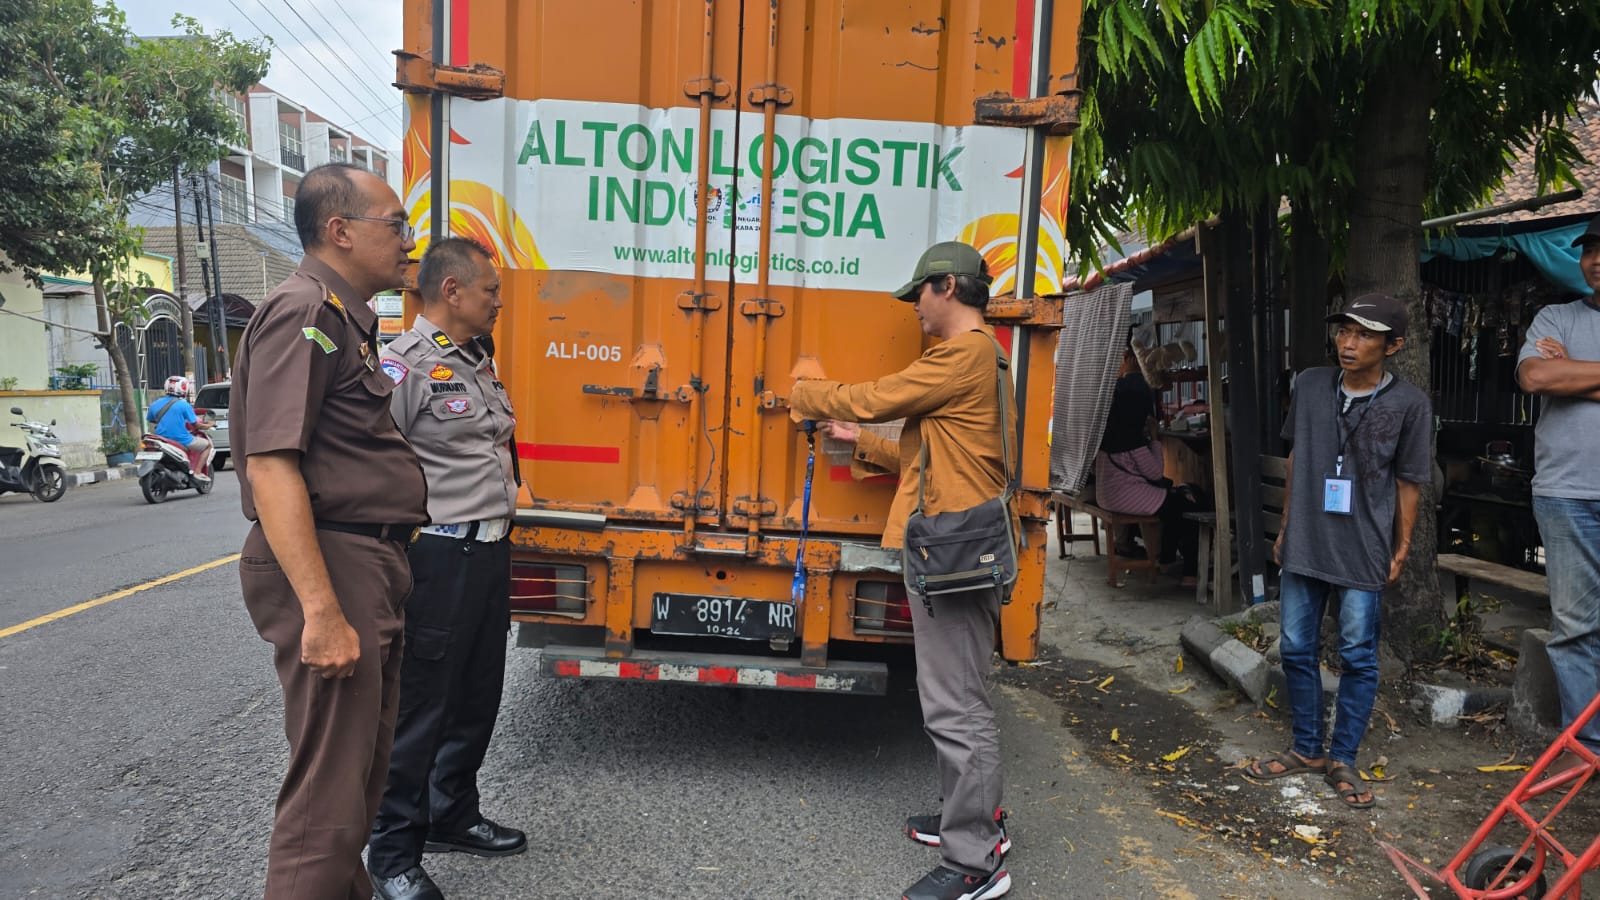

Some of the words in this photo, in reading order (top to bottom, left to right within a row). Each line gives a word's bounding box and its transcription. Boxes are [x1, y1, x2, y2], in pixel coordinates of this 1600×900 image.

[517, 119, 695, 173] ALTON
[711, 129, 965, 192] LOGISTIK
[588, 175, 886, 239] INDESIA
[613, 245, 860, 276] www.altnlogitics.co.id
[545, 341, 621, 361] ALI-005
[656, 597, 670, 620] W
[697, 599, 747, 623] 8914
[768, 602, 793, 628] NR
